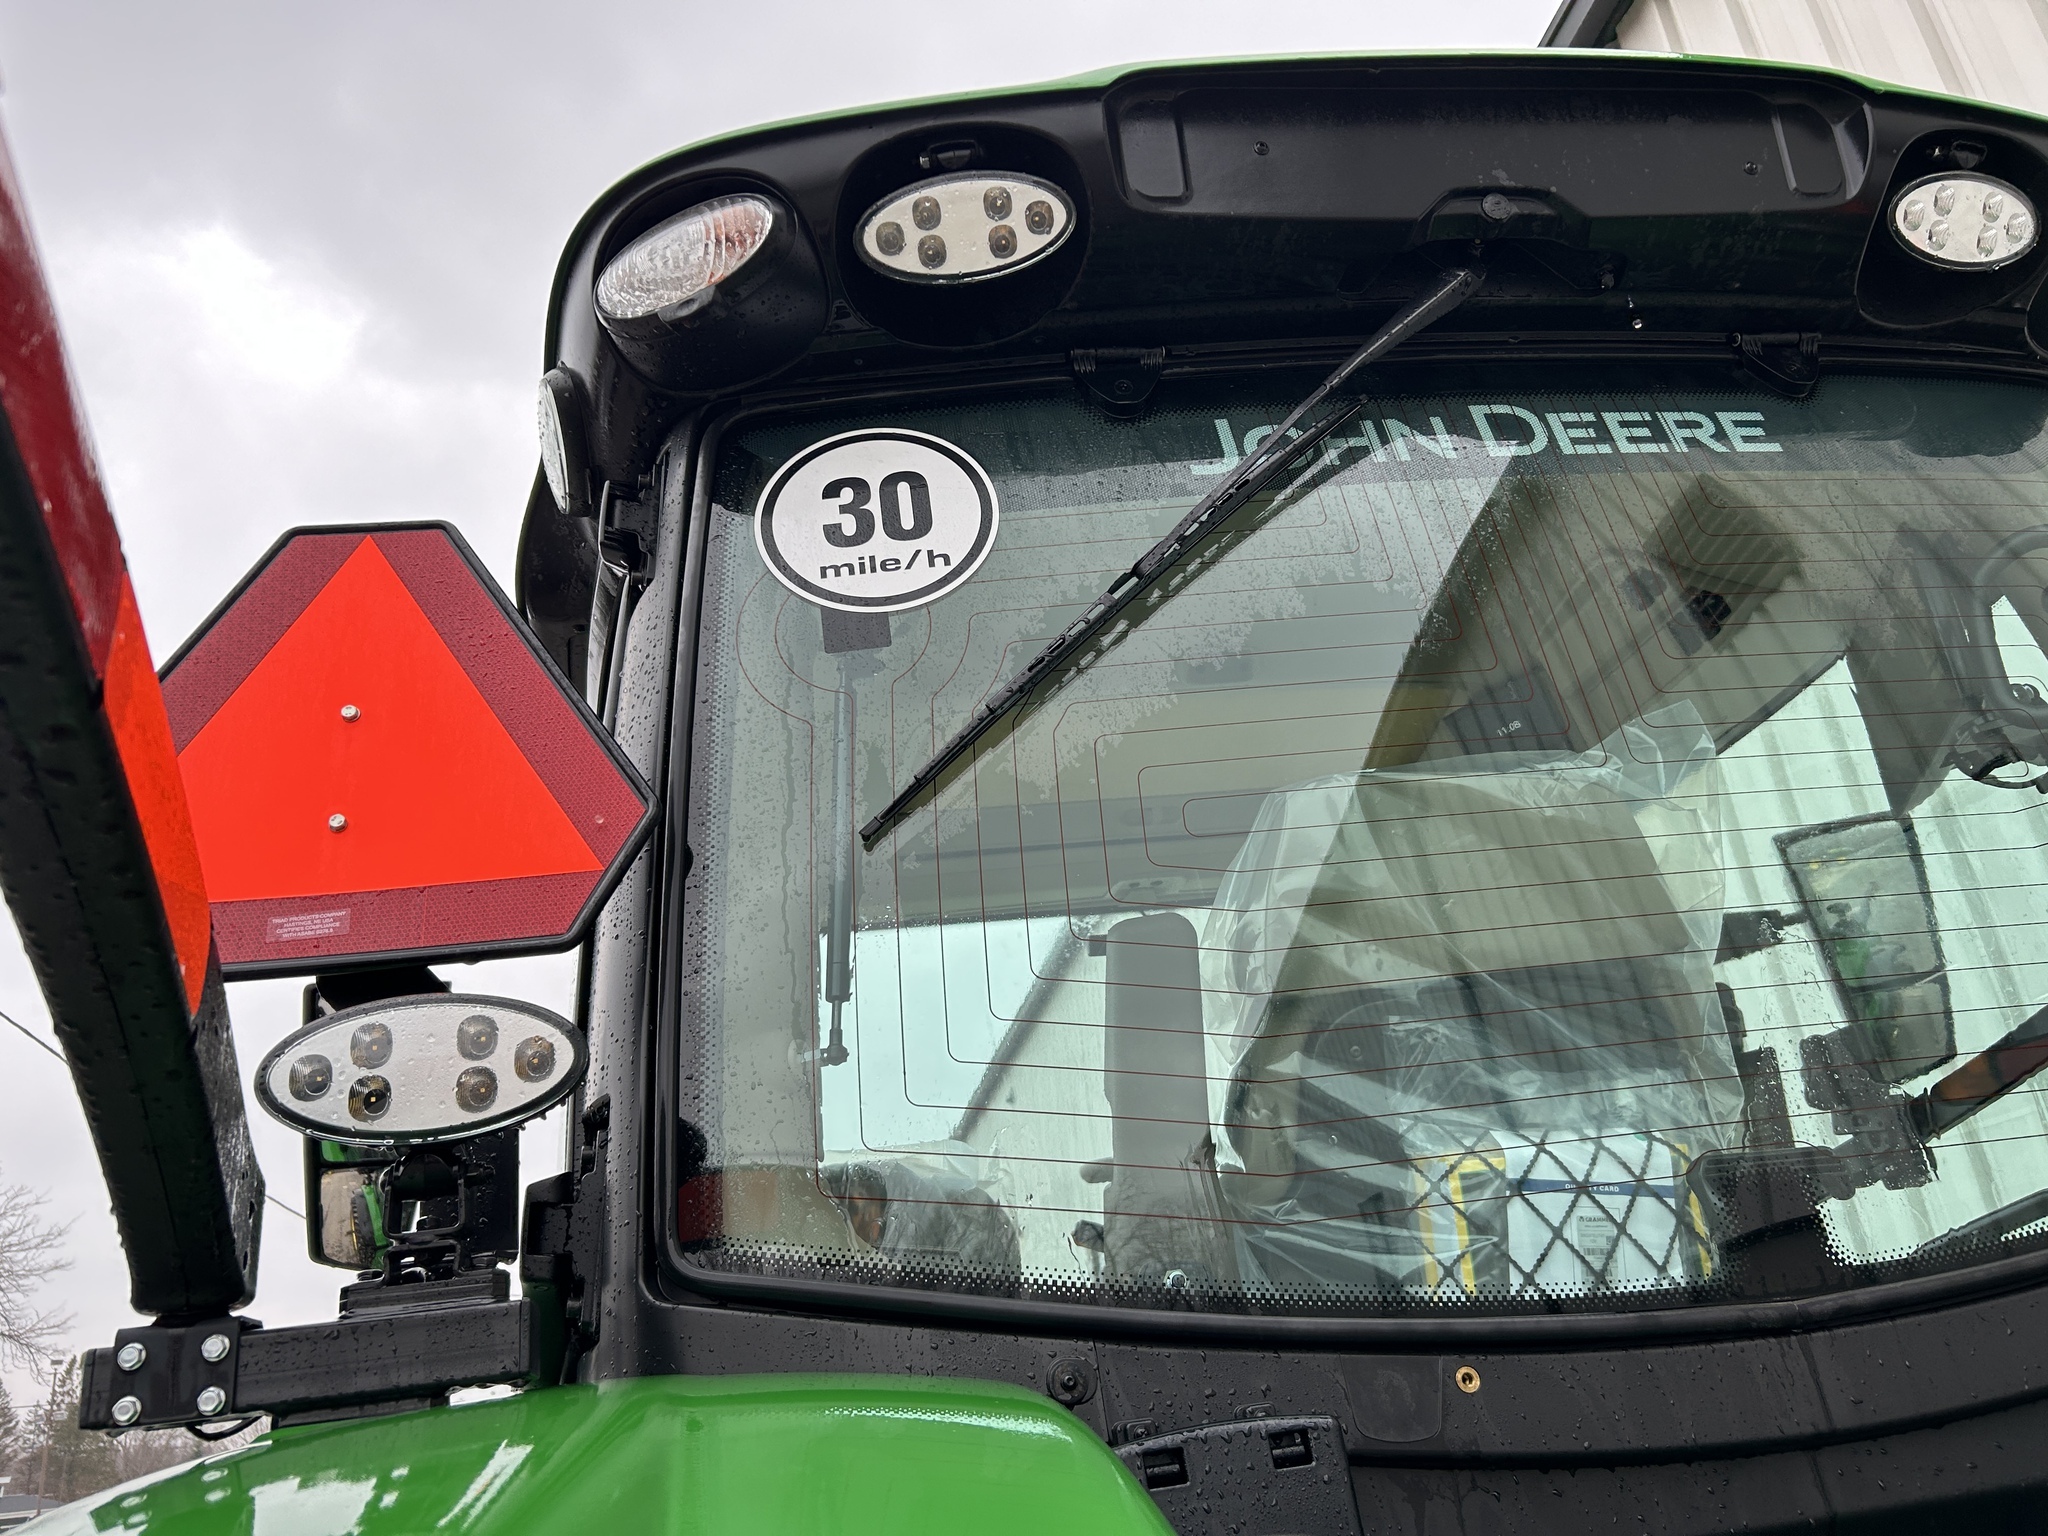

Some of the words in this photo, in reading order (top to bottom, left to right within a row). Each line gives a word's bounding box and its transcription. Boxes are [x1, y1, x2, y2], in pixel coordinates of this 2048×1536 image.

[1189, 416, 1457, 475] JOHN
[1468, 403, 1784, 458] DEERE
[821, 470, 934, 548] 30
[820, 549, 952, 580] mile/h
[305, 921, 340, 930] COMPLIANCE
